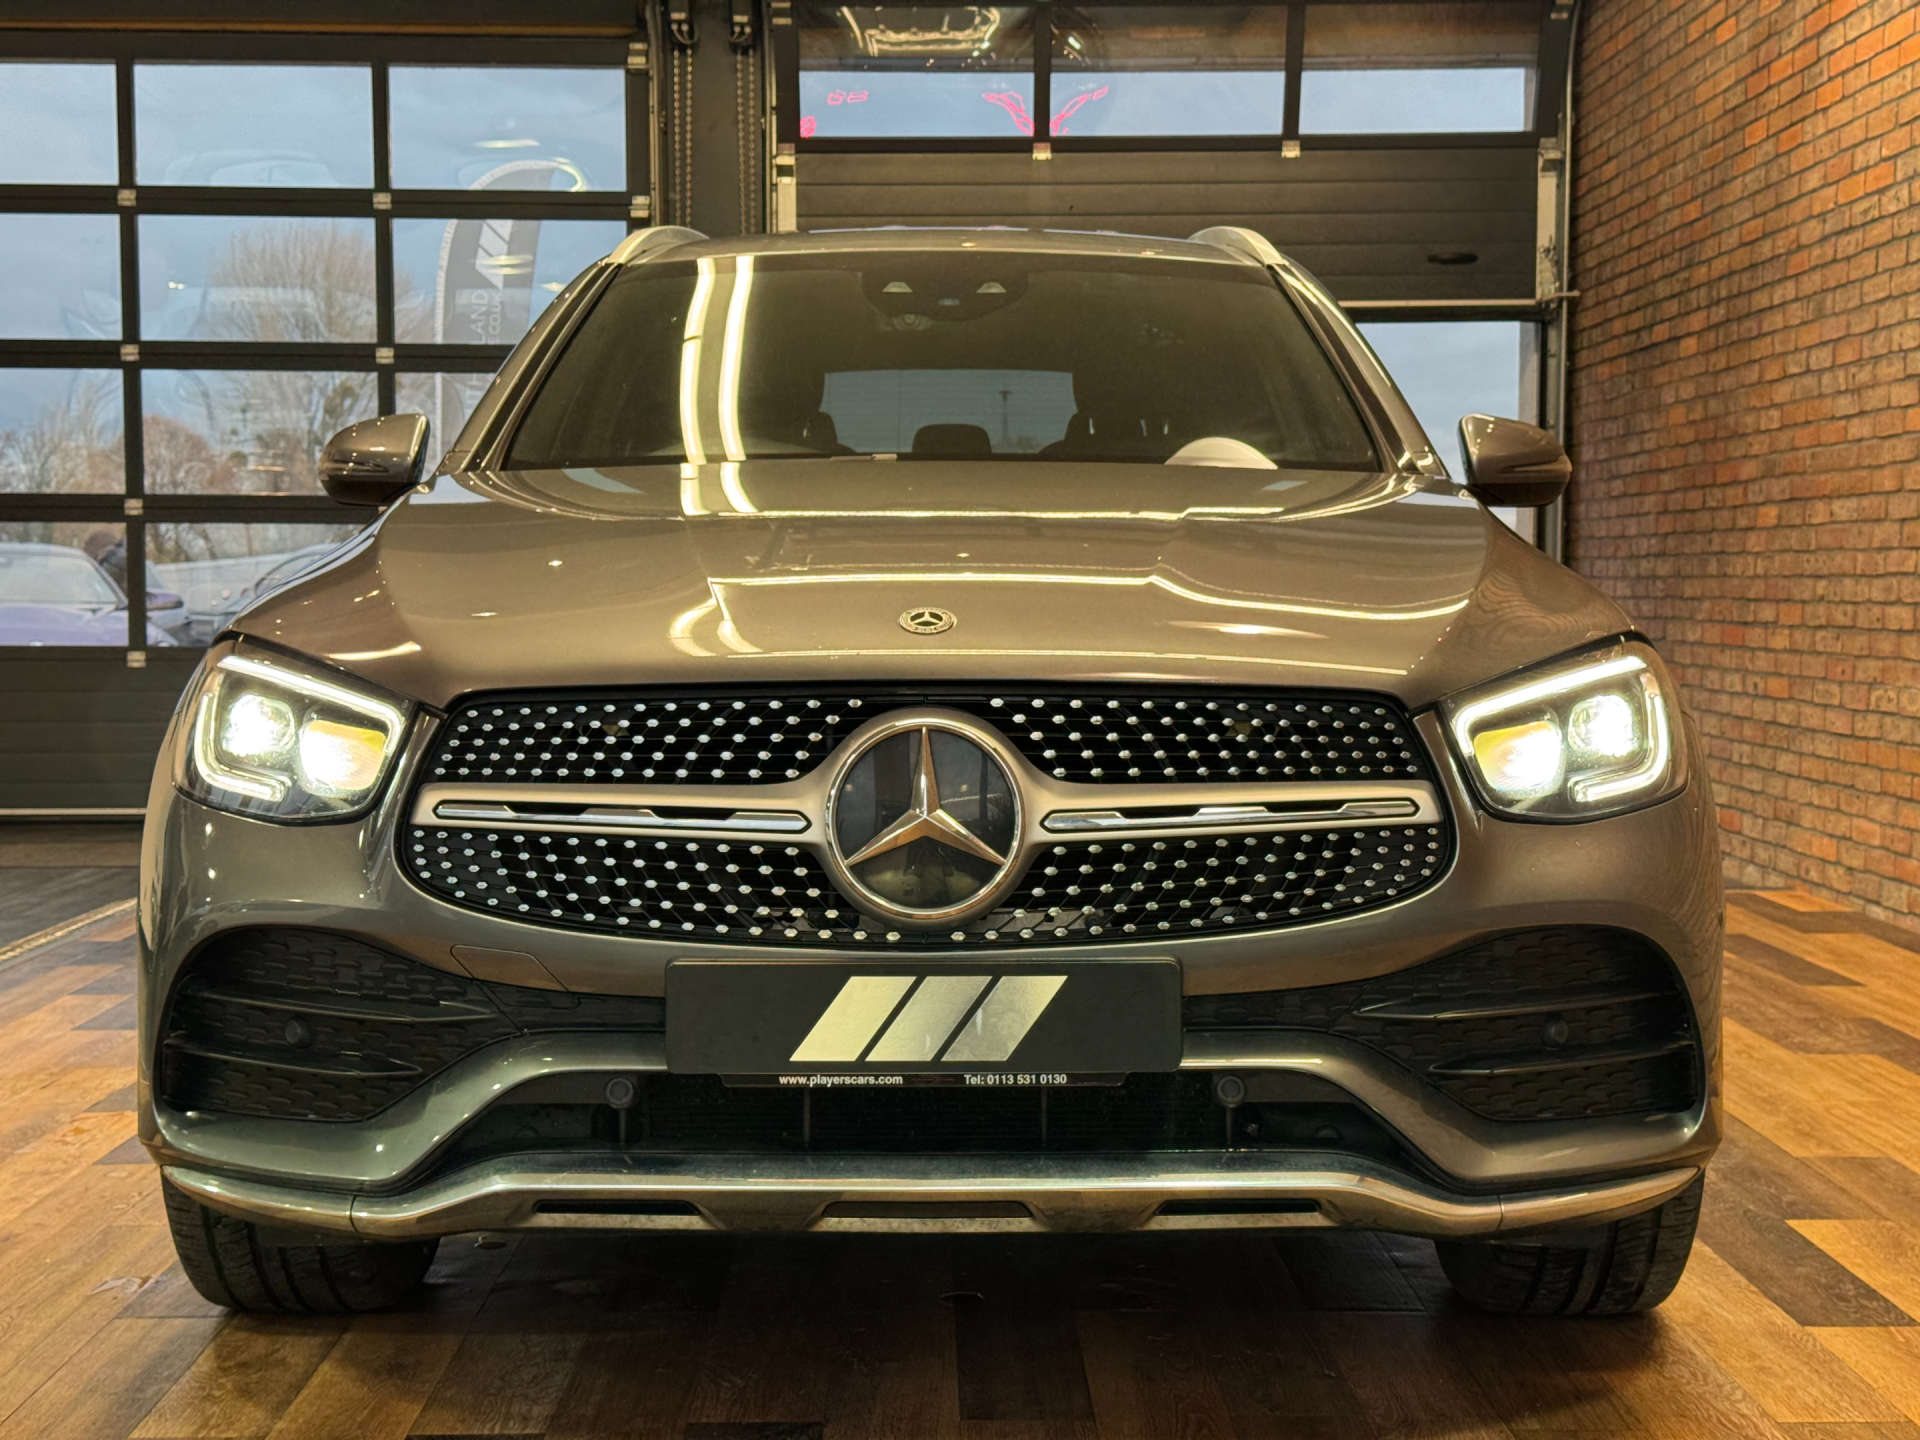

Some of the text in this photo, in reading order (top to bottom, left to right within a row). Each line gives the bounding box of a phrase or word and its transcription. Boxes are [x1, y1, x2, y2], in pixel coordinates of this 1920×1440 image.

[778, 1074, 903, 1088] www.playerscars.com
[963, 1073, 1067, 1085] Tel: 0113 531 0130
